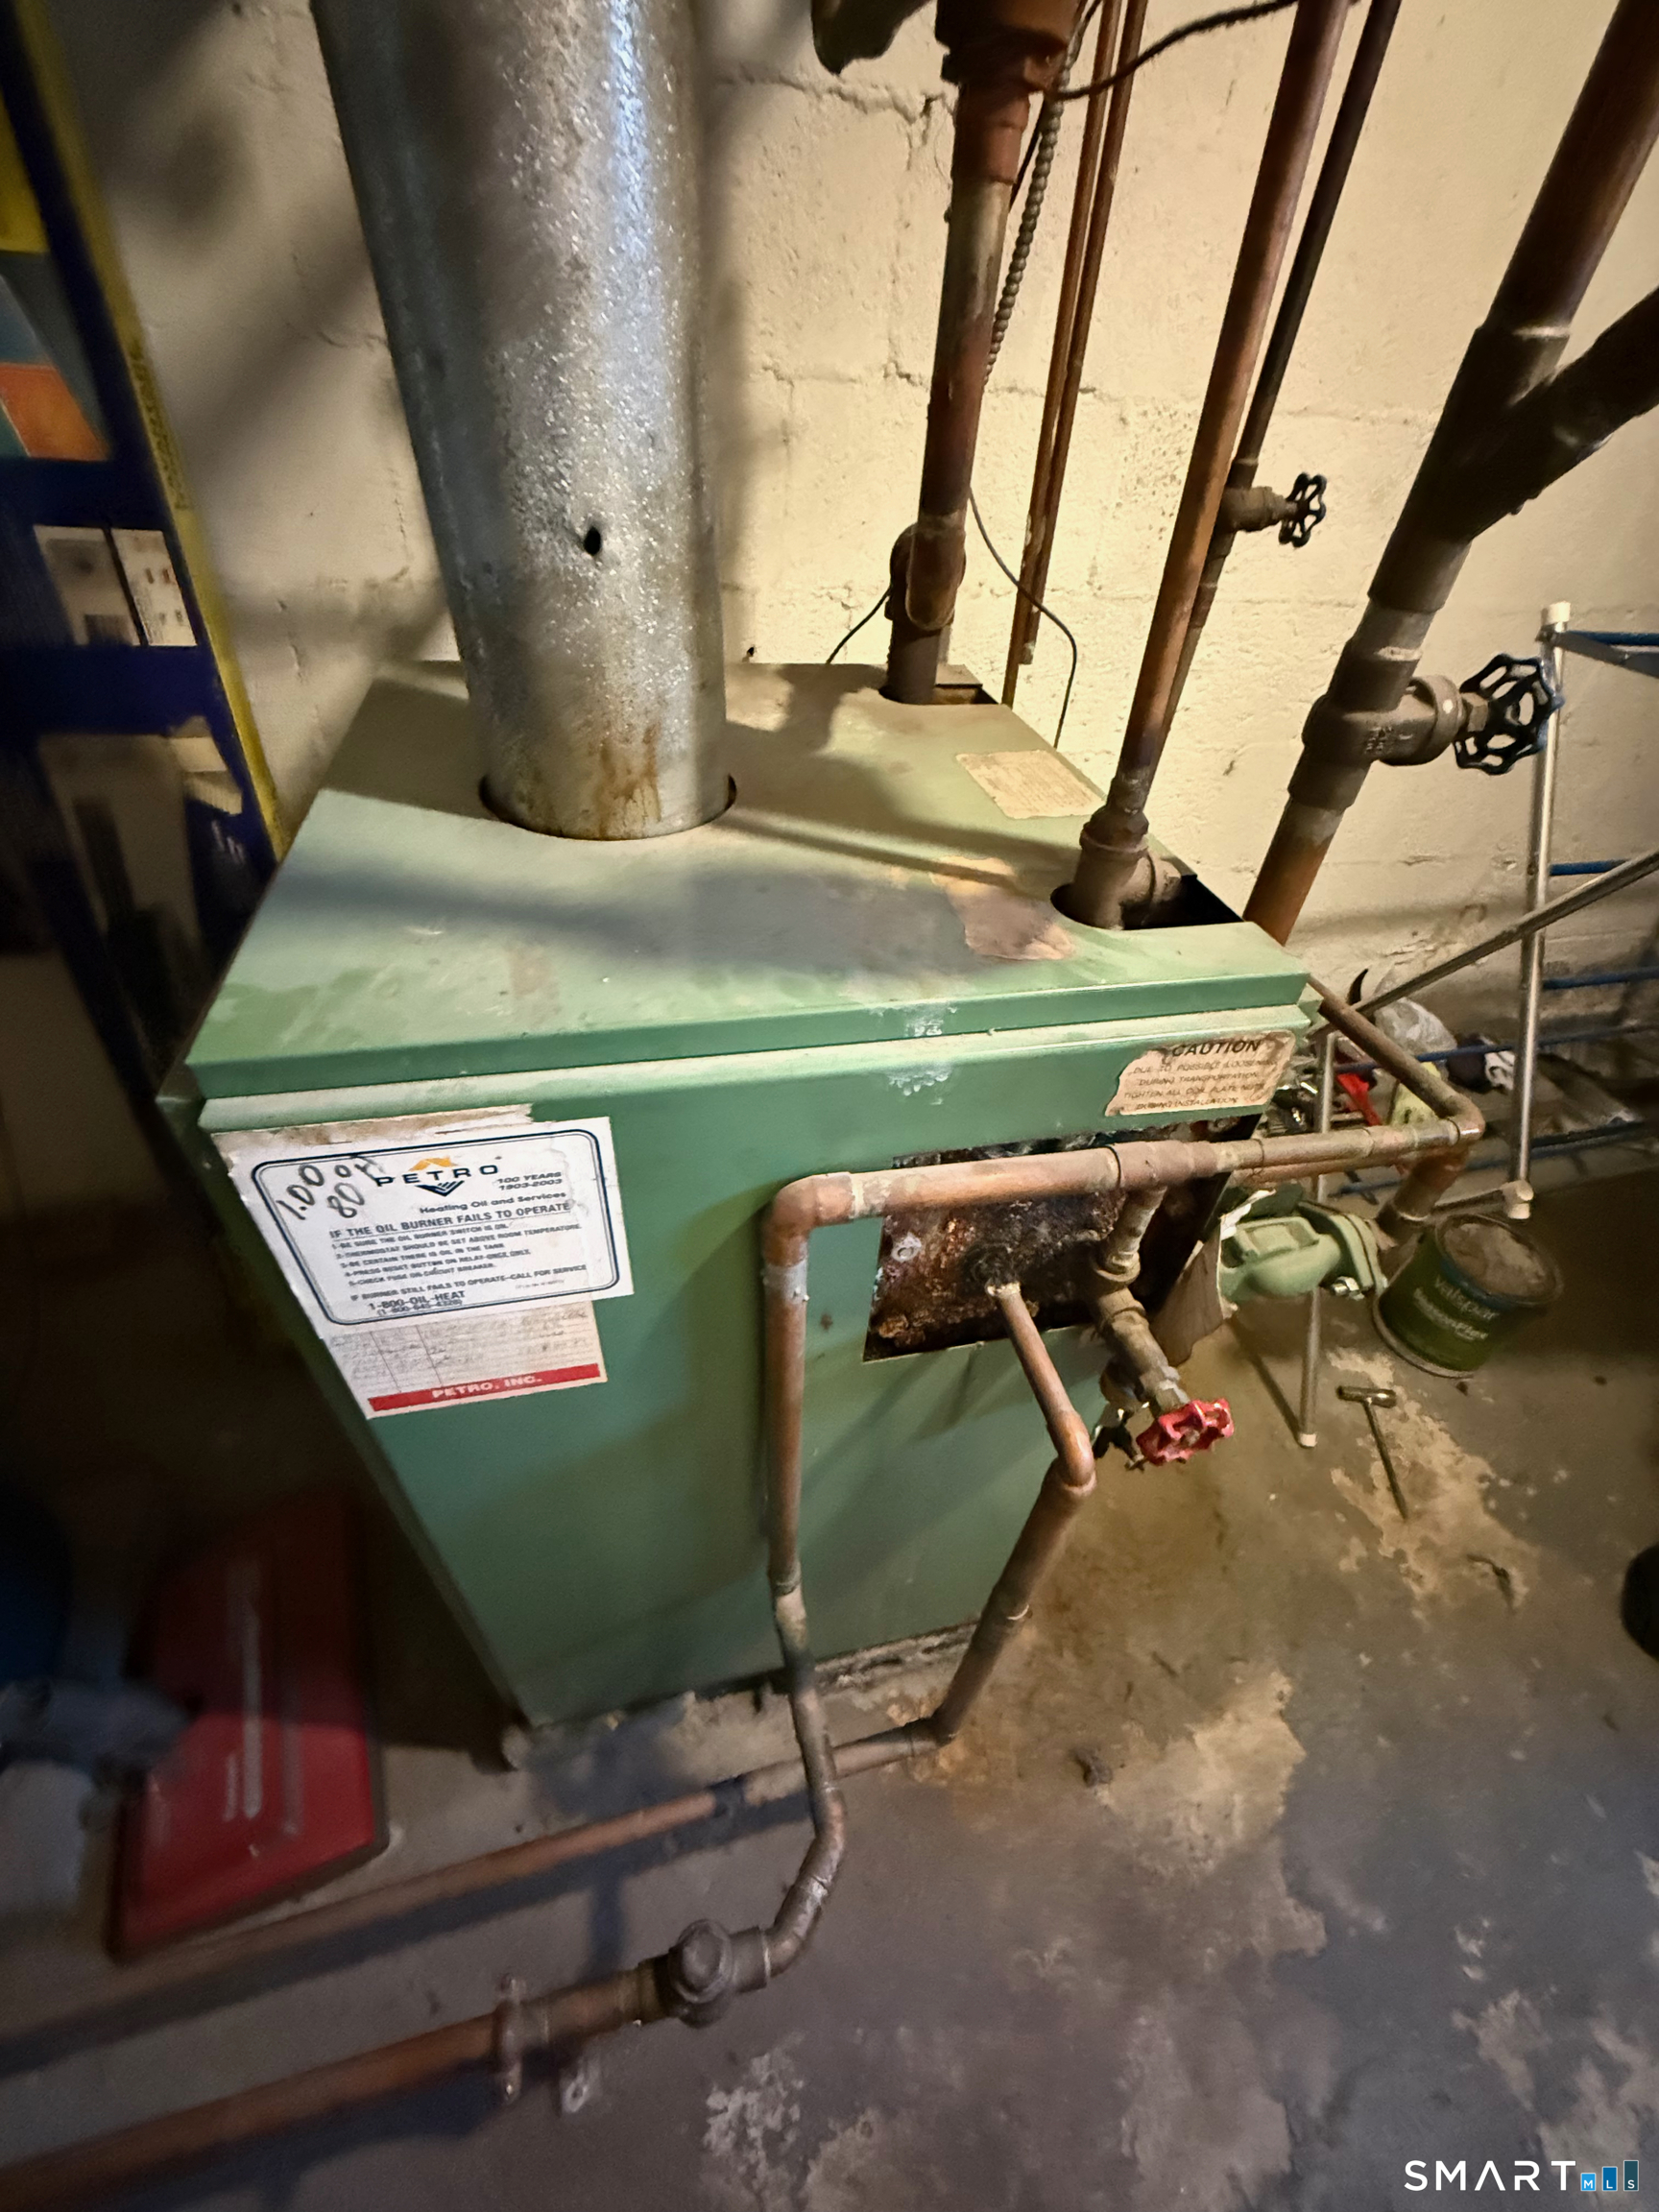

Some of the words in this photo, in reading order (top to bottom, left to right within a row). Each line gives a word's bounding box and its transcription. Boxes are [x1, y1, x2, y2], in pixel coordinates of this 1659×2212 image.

[1172, 1040, 1261, 1057] CAUTION
[375, 1165, 499, 1187] PETRO
[499, 1178, 563, 1190] 1903-2003
[523, 1171, 562, 1181] YEARS
[420, 1204, 469, 1214] Heating
[470, 1199, 488, 1208] Oil
[491, 1197, 515, 1206] and
[517, 1192, 566, 1202] Services
[329, 1230, 342, 1238] IF
[347, 1227, 373, 1237] THE
[375, 1224, 397, 1234] OIL
[400, 1216, 453, 1230] BURNER
[456, 1212, 492, 1224] FAILS
[495, 1210, 512, 1219] TO
[516, 1202, 571, 1216] OPERATE
[449, 1226, 482, 1235] SWITCH
[400, 1286, 425, 1295] STILL
[427, 1283, 452, 1291] FAILS
[553, 1264, 587, 1274] SERVICE
[504, 1376, 543, 1388] INC.
